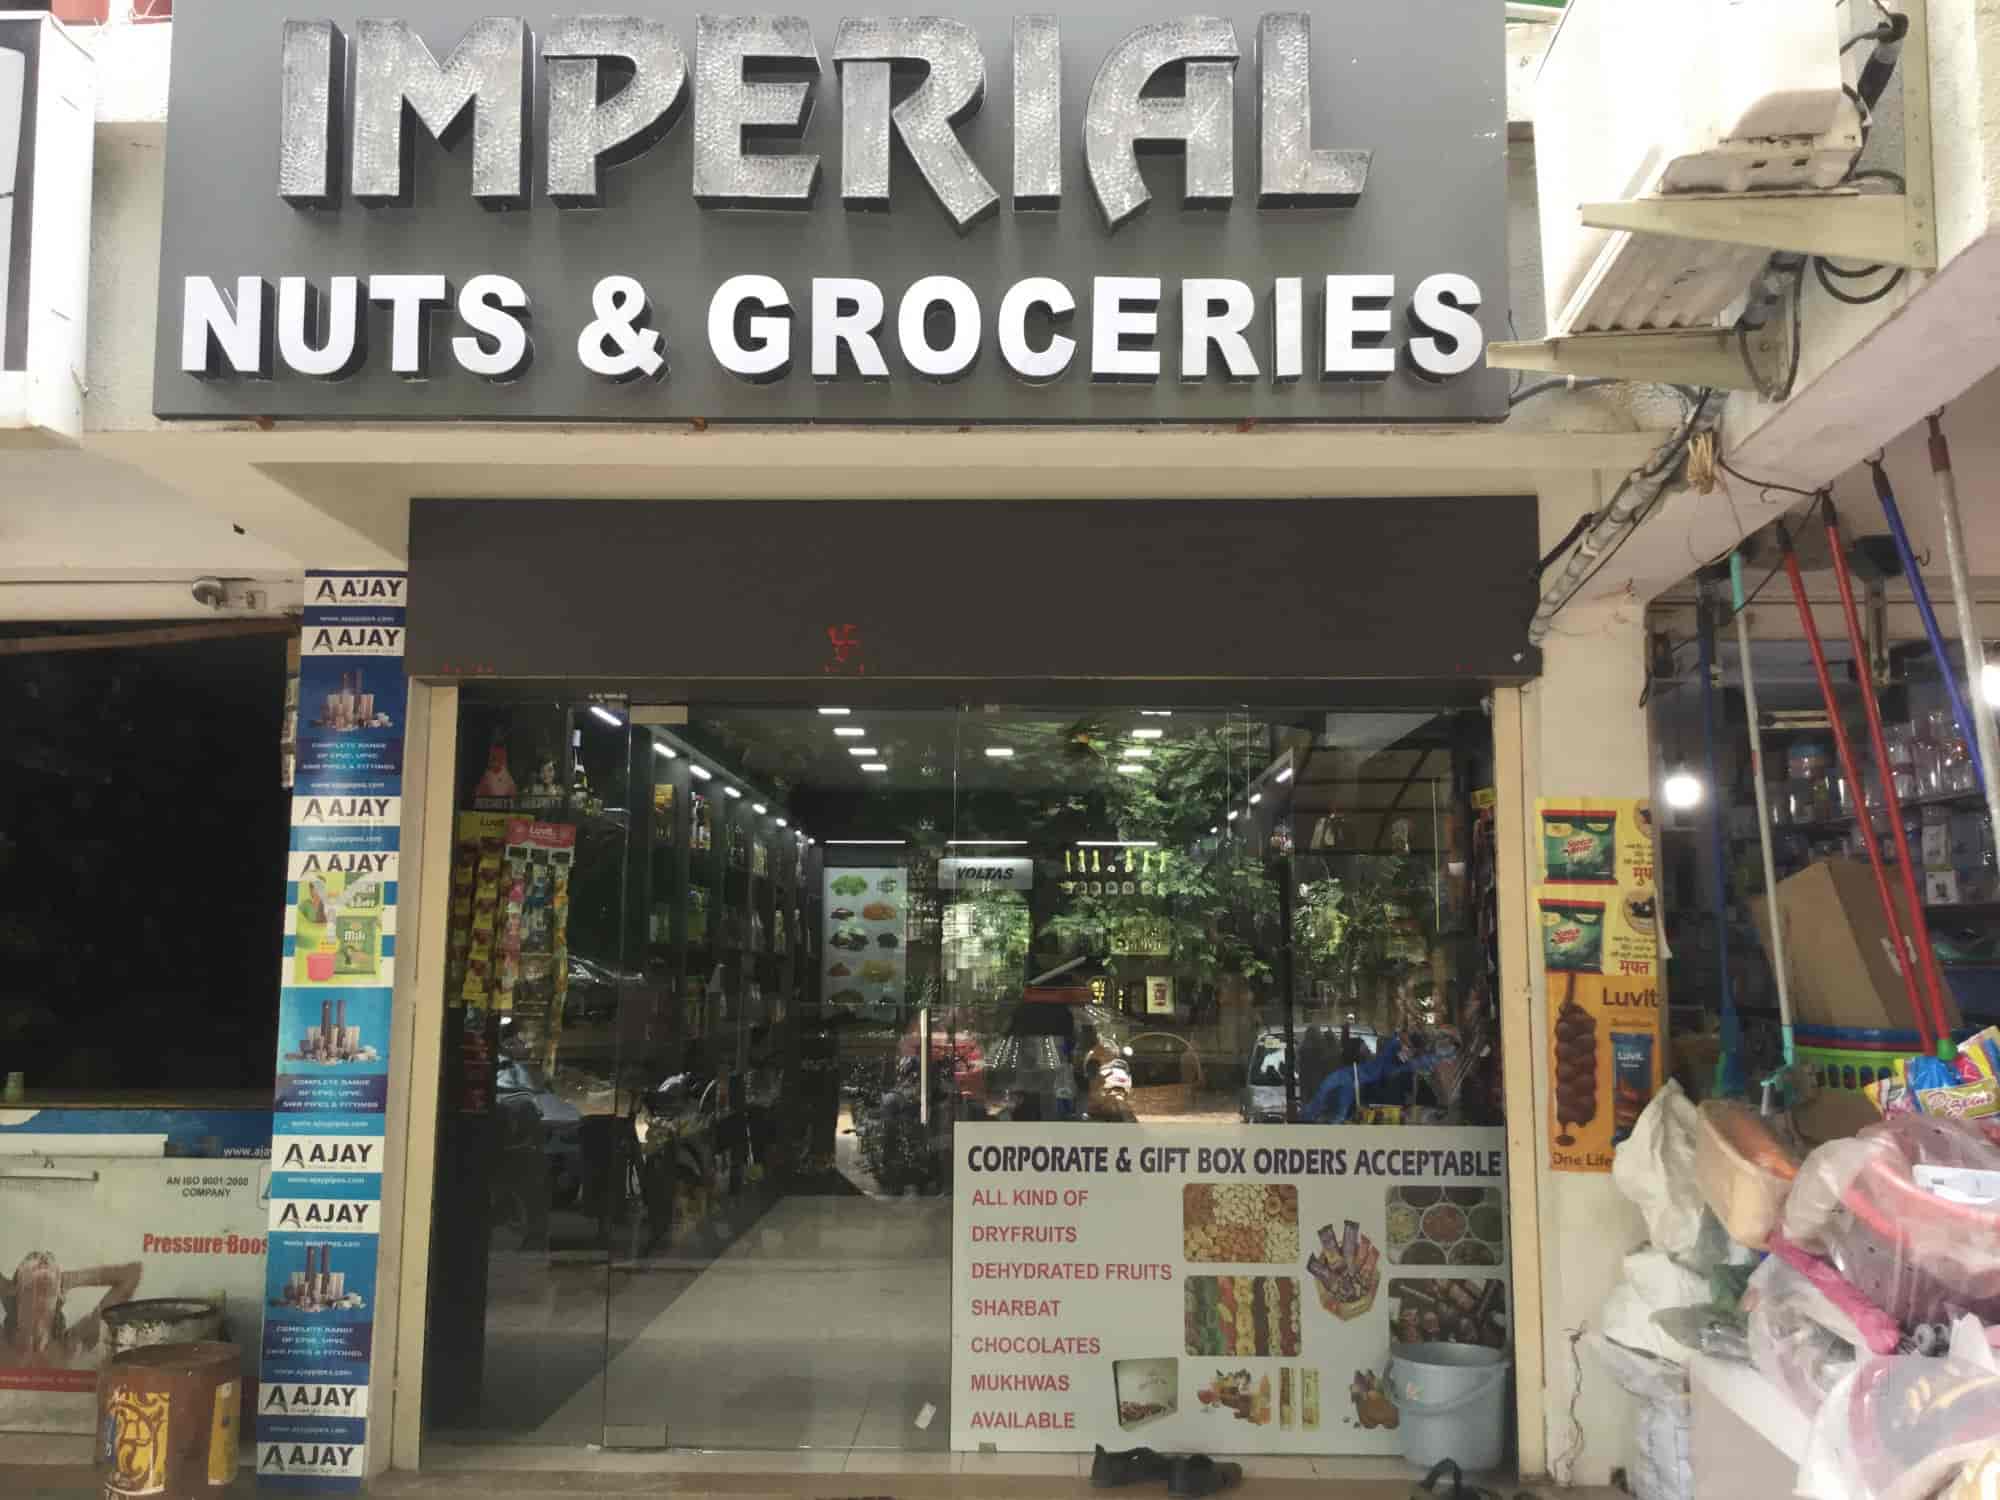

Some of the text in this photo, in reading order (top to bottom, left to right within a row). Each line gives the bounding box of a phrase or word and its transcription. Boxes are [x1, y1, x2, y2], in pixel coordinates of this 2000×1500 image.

[277, 11, 1375, 232] IMPERIAL
[181, 273, 1484, 382] NUTS & GROCERIES
[341, 579, 402, 597] AJAY
[338, 629, 400, 646] AJAY
[329, 799, 390, 816] AJAY
[327, 854, 389, 872] AJAY
[957, 867, 1015, 880] VOLTAS
[1602, 987, 1658, 1008] Luvit
[309, 1144, 373, 1162] AJAY
[968, 1145, 1502, 1177] CORPORATE & GIFT BOX ORDERS ACCEPTABLE
[166, 1176, 181, 1185] AN
[183, 1176, 200, 1185] ISO
[182, 1188, 232, 1198] COMPANY
[972, 1190, 1089, 1206] ALL KIND OF
[305, 1203, 369, 1222] AJAY
[971, 1225, 1078, 1243] DRYFRUITS
[143, 1234, 222, 1255] Pressure
[971, 1263, 1172, 1281] DEHYDRATED FRUITS
[971, 1299, 1062, 1317] SHARBAT
[971, 1336, 1101, 1354] CHOCOLATES
[970, 1374, 1070, 1392] MUKHWAS
[292, 1387, 357, 1406] AJAY
[970, 1412, 1076, 1430] AVAILABLE
[288, 1446, 354, 1466] AJAY
